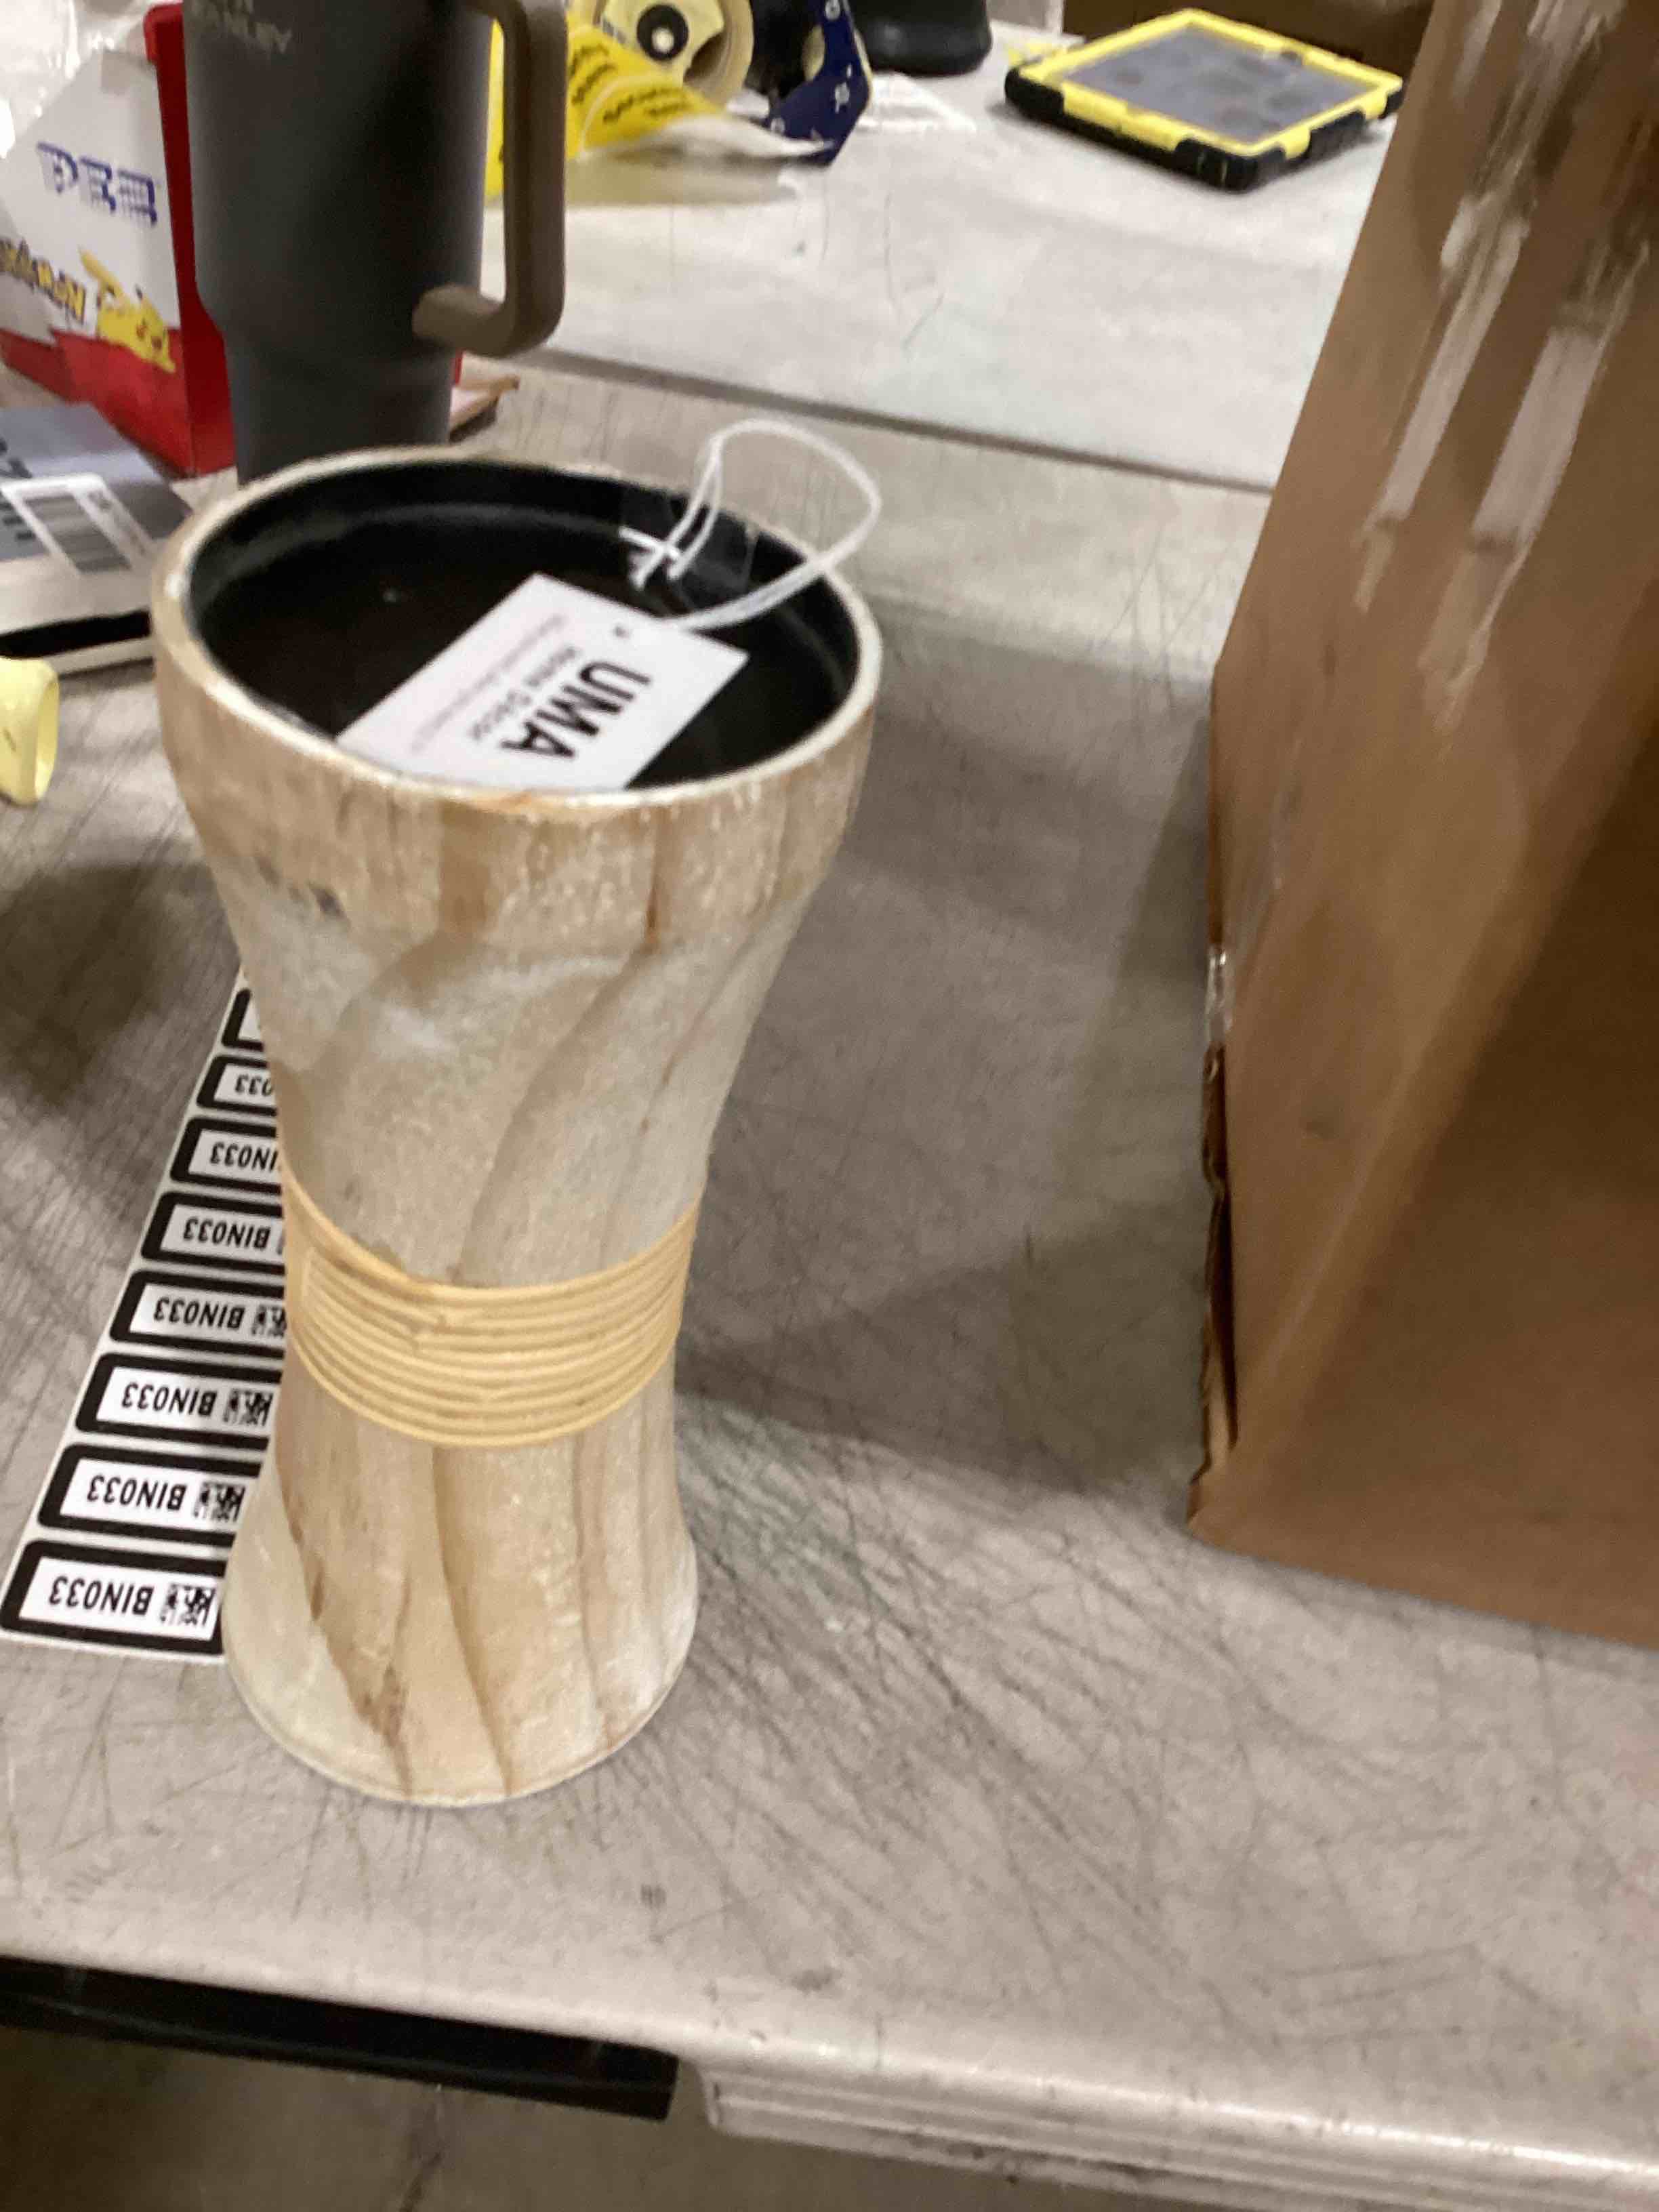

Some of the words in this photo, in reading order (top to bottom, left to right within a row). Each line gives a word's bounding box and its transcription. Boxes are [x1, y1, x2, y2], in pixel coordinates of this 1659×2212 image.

[500, 661, 651, 758] UMA
[209, 1142, 278, 1172] IN033
[184, 1216, 270, 1244] BIN033
[154, 1296, 246, 1328] BIN033
[122, 1382, 218, 1416] BIN033
[87, 1475, 188, 1511] BIN033
[48, 1576, 155, 1615] BIN033
